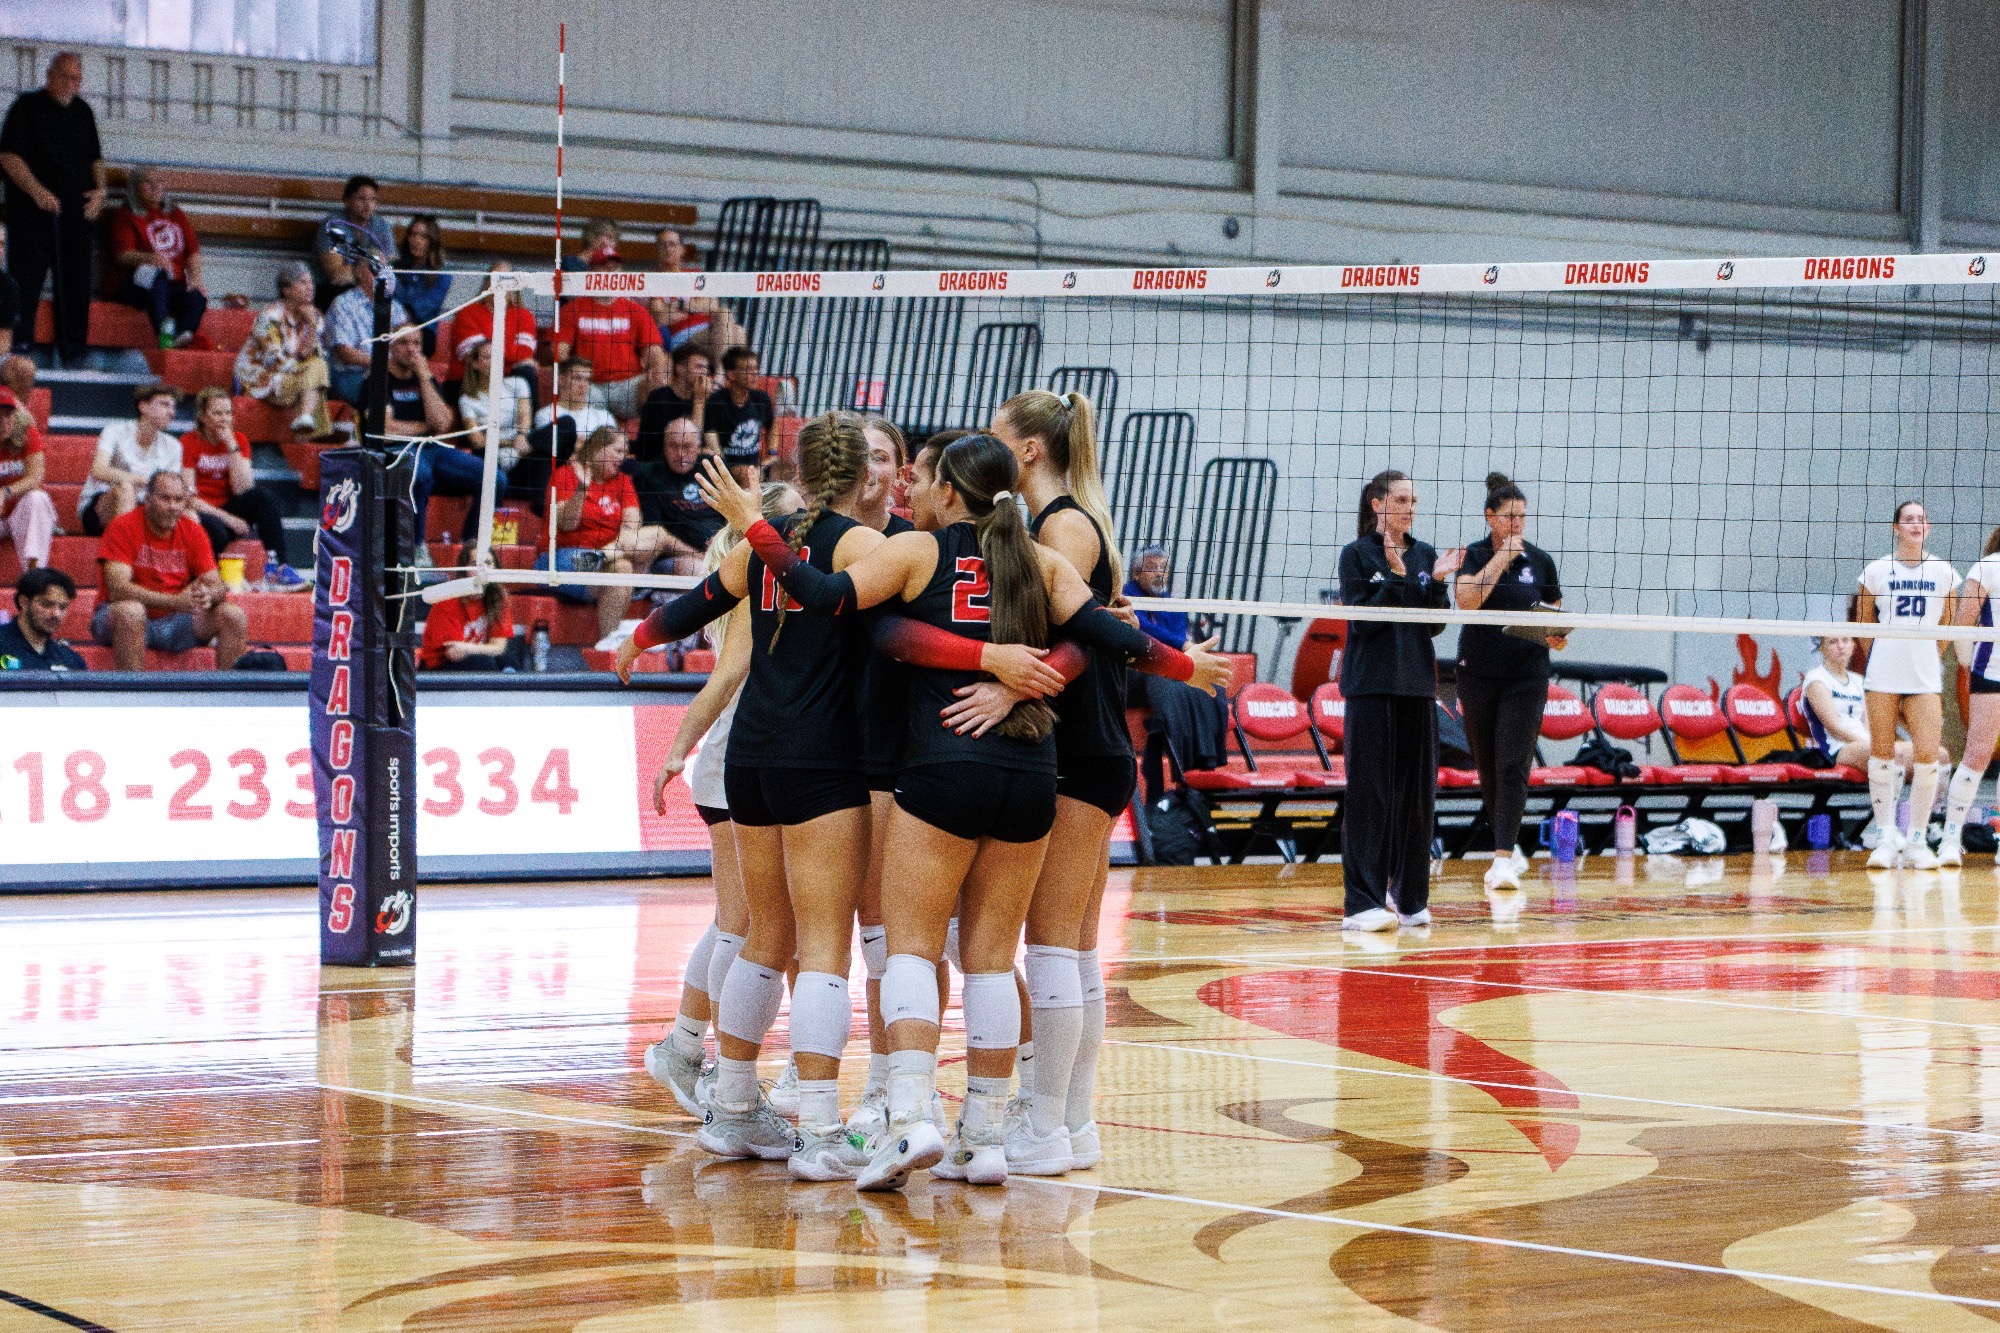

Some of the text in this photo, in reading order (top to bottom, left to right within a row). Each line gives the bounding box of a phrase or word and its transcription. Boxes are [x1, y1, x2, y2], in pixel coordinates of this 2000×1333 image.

[1134, 270, 1207, 290] DRAGONS
[1342, 267, 1420, 288] DRAGONS
[1565, 263, 1649, 286] DRAGONS
[1804, 258, 1895, 281] DRAGONS
[586, 273, 645, 291] DRAGONS
[757, 273, 821, 292] DRAGONS
[940, 272, 1008, 291] DRAGONS
[1888, 580, 1935, 592] WARRIORS
[1896, 595, 1926, 617] 20
[329, 556, 356, 933] DRAGONS
[0, 748, 318, 823] 18-233
[388, 757, 401, 881] sports imports
